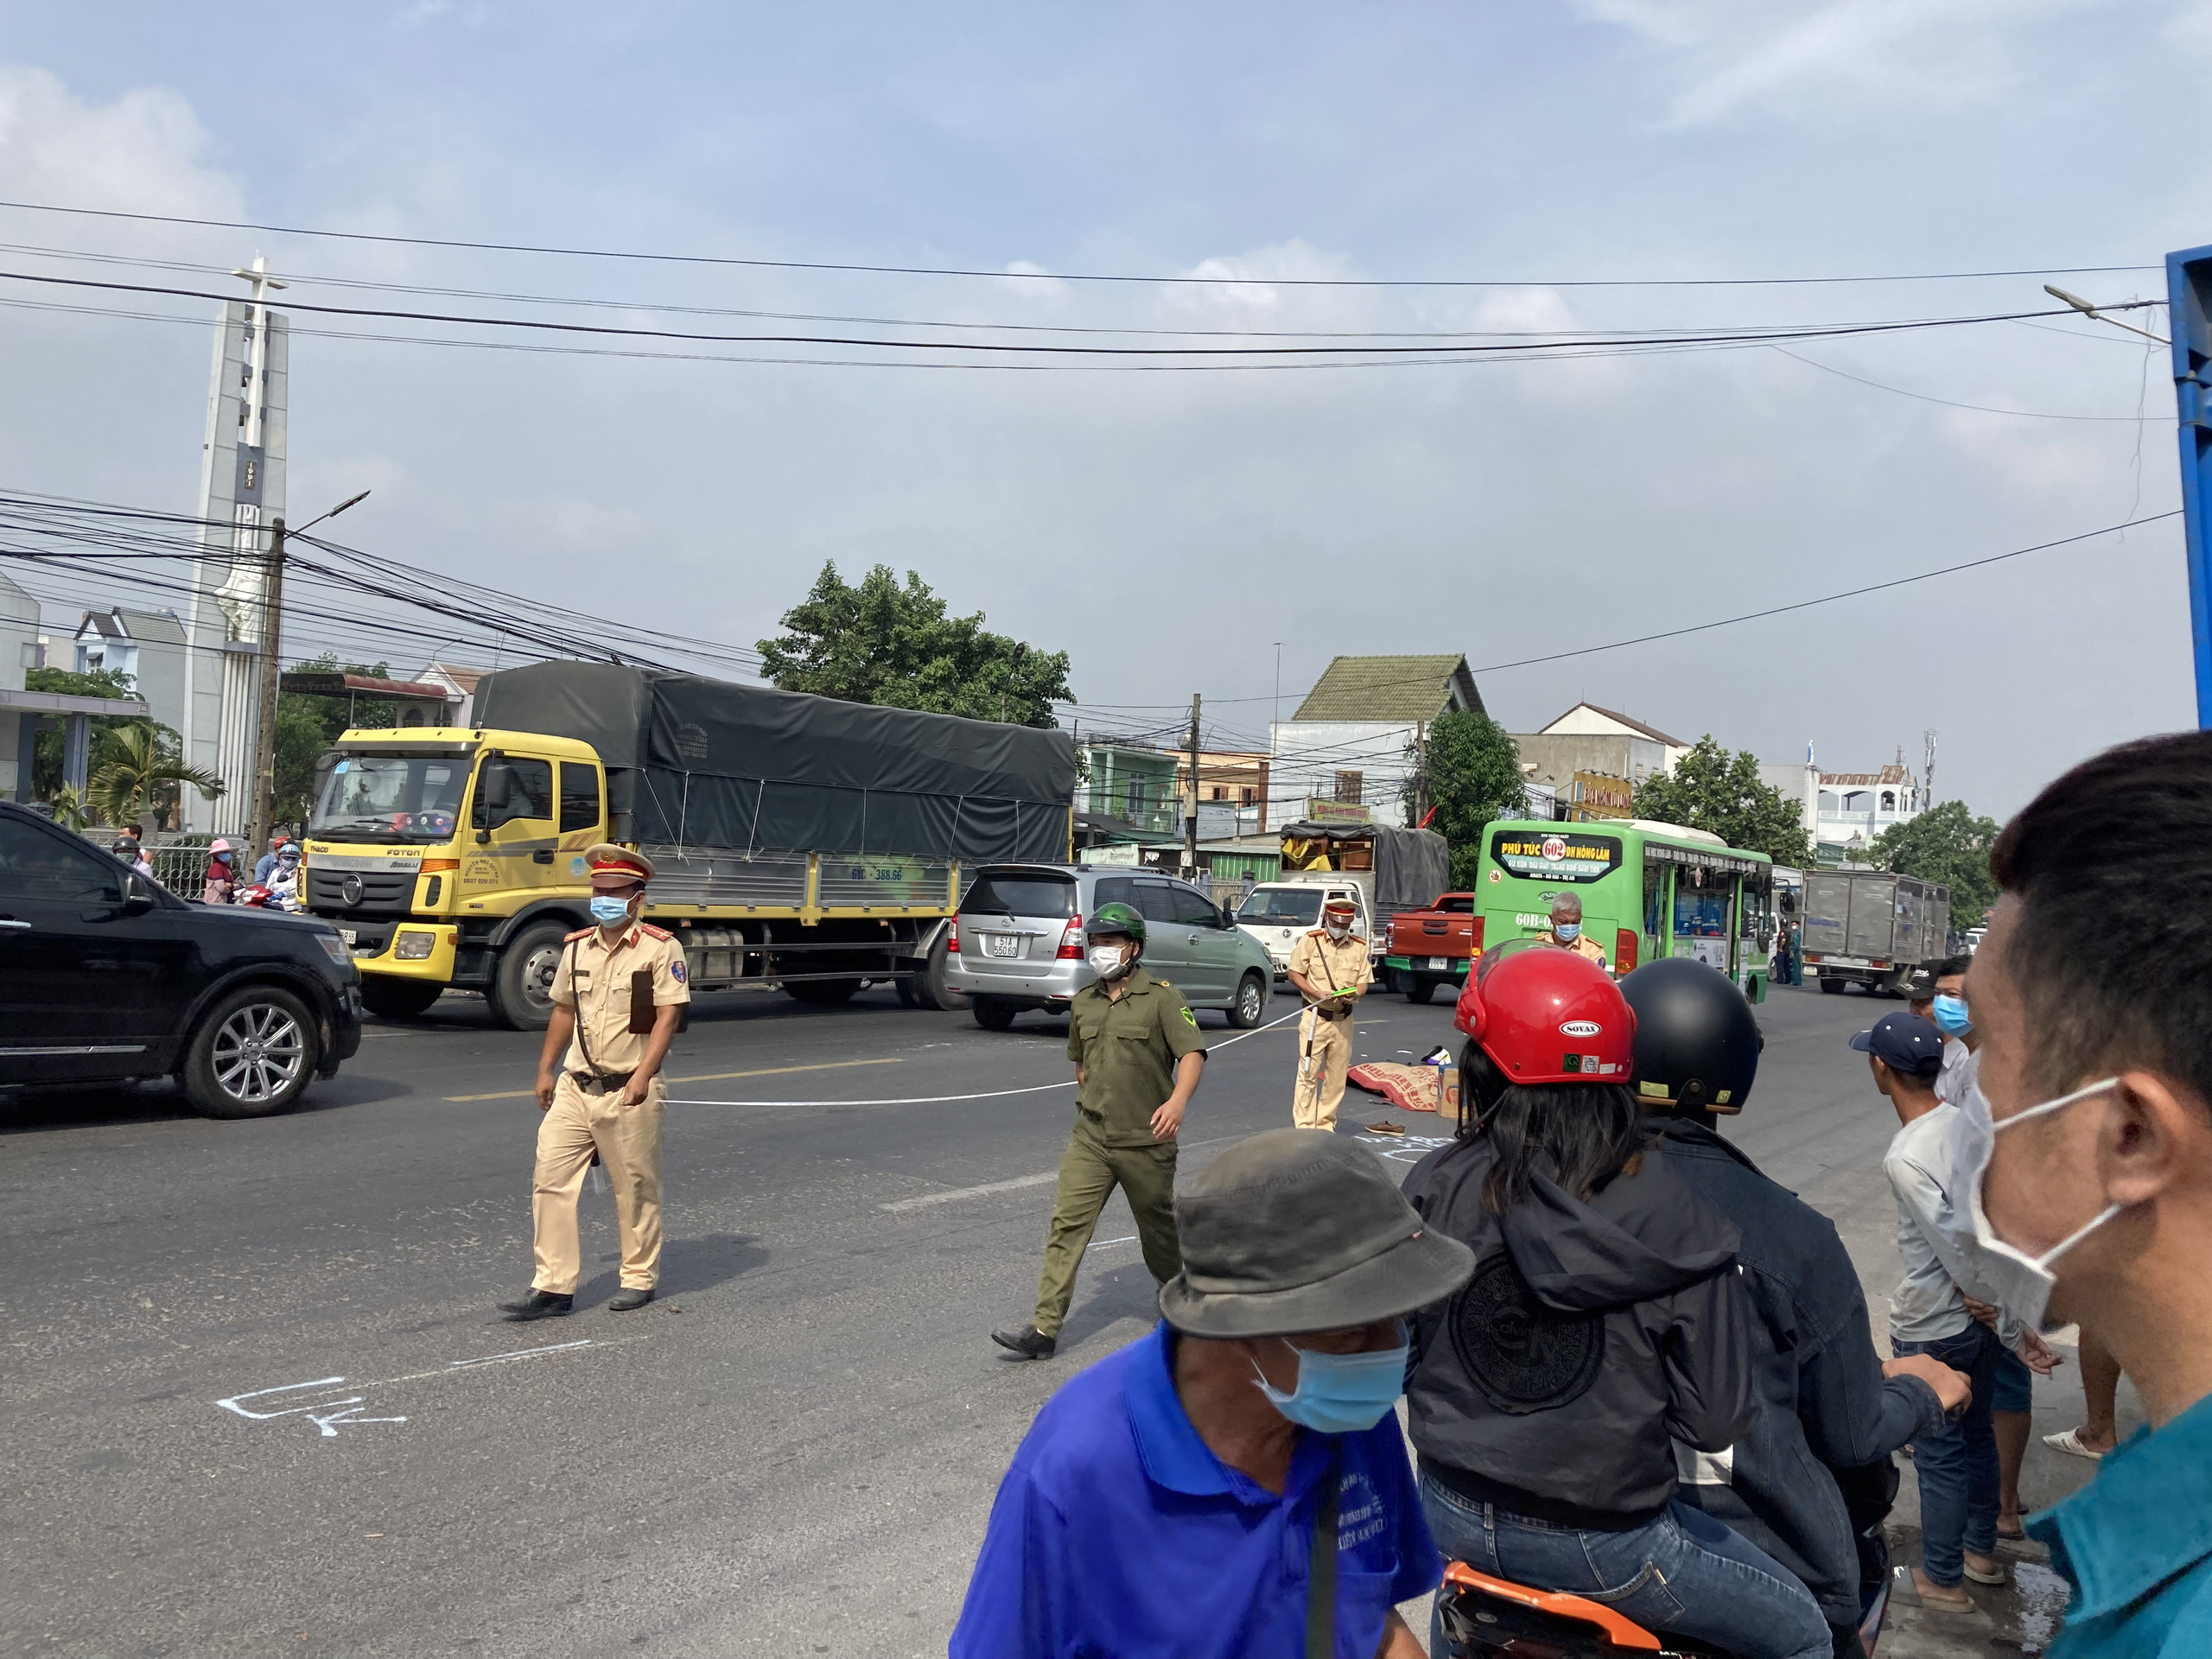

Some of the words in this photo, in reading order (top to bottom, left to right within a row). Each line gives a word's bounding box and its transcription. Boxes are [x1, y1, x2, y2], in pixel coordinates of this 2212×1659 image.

[1502, 841, 1521, 855] PHÚ
[1522, 842, 1541, 855] TÚC
[1544, 842, 1563, 856] 602
[875, 869, 902, 880] 388.66
[1516, 912, 1554, 928] 60B-0
[1000, 937, 1013, 946] 51A
[994, 946, 1017, 956] 550.60
